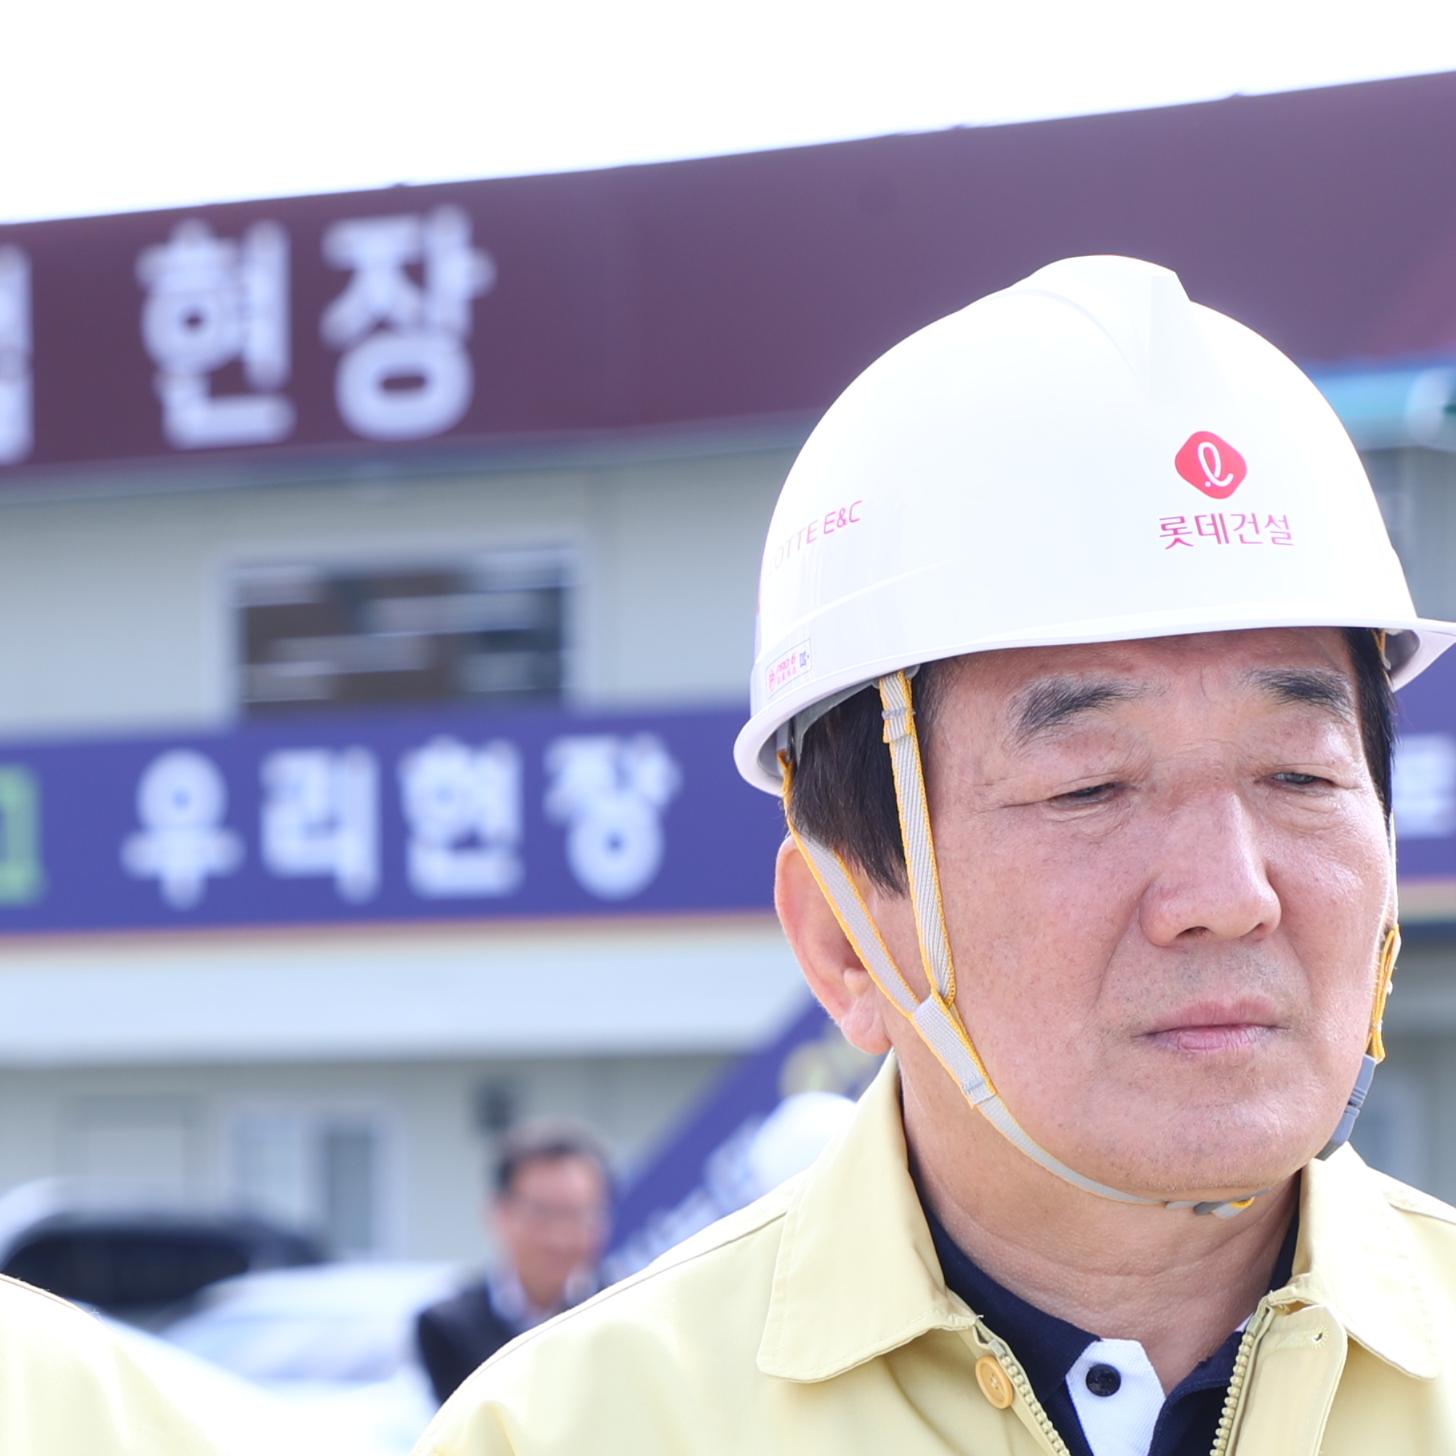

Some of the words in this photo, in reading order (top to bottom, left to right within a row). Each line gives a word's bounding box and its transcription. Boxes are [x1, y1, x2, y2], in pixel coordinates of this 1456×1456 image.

[136, 205, 496, 450] 현장
[823, 499, 862, 535] E&C
[1159, 512, 1294, 550] 롯데건설
